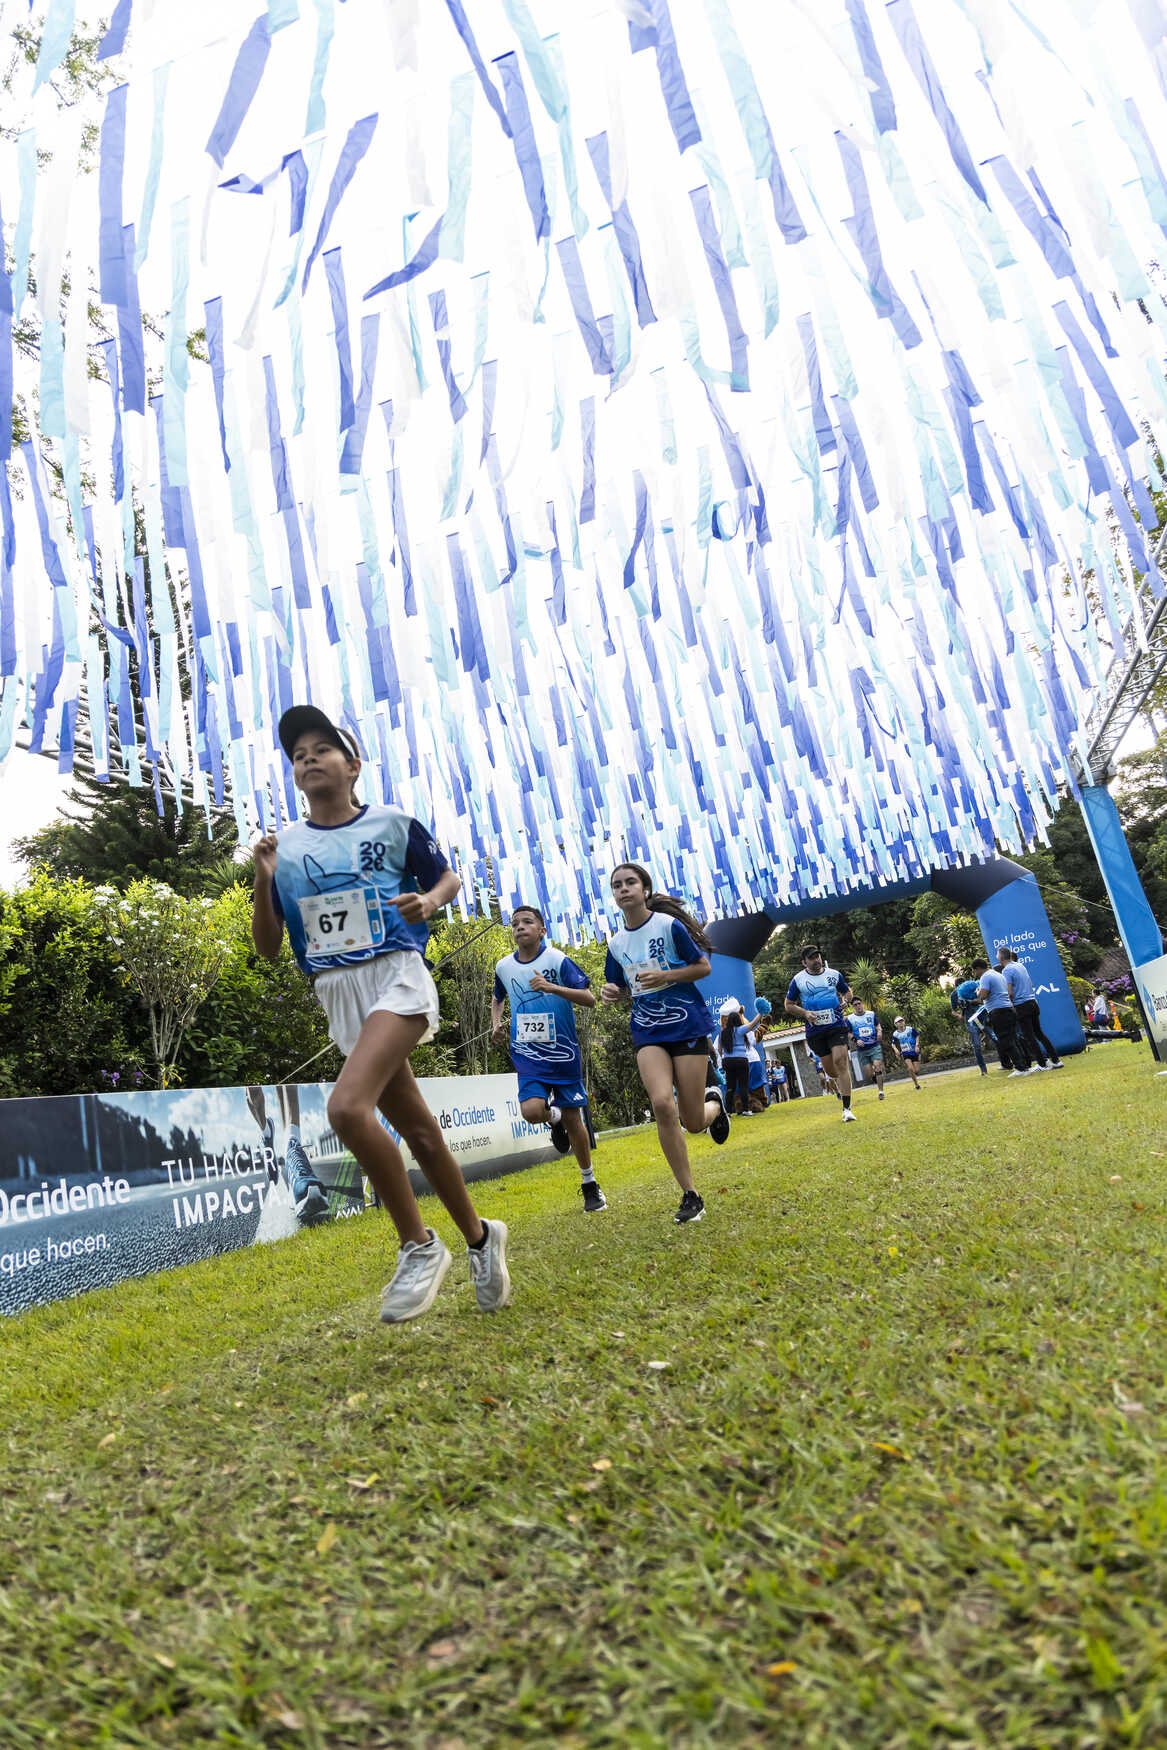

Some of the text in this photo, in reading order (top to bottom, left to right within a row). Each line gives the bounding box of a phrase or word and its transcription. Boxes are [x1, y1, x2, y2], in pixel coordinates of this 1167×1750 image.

[360, 841, 386, 857] 20
[318, 909, 348, 934] 67
[648, 937, 665, 949] 20
[993, 930, 1035, 949] Del lado
[1028, 940, 1047, 951] que
[542, 968, 557, 979] 20
[523, 1022, 545, 1033] 732
[439, 1110, 452, 1129] de
[452, 1105, 496, 1128] Occidente
[506, 1100, 518, 1118] TU
[460, 1140, 473, 1152] que
[161, 1146, 277, 1189] TU HACER
[1, 1232, 111, 1278] que hacen.
